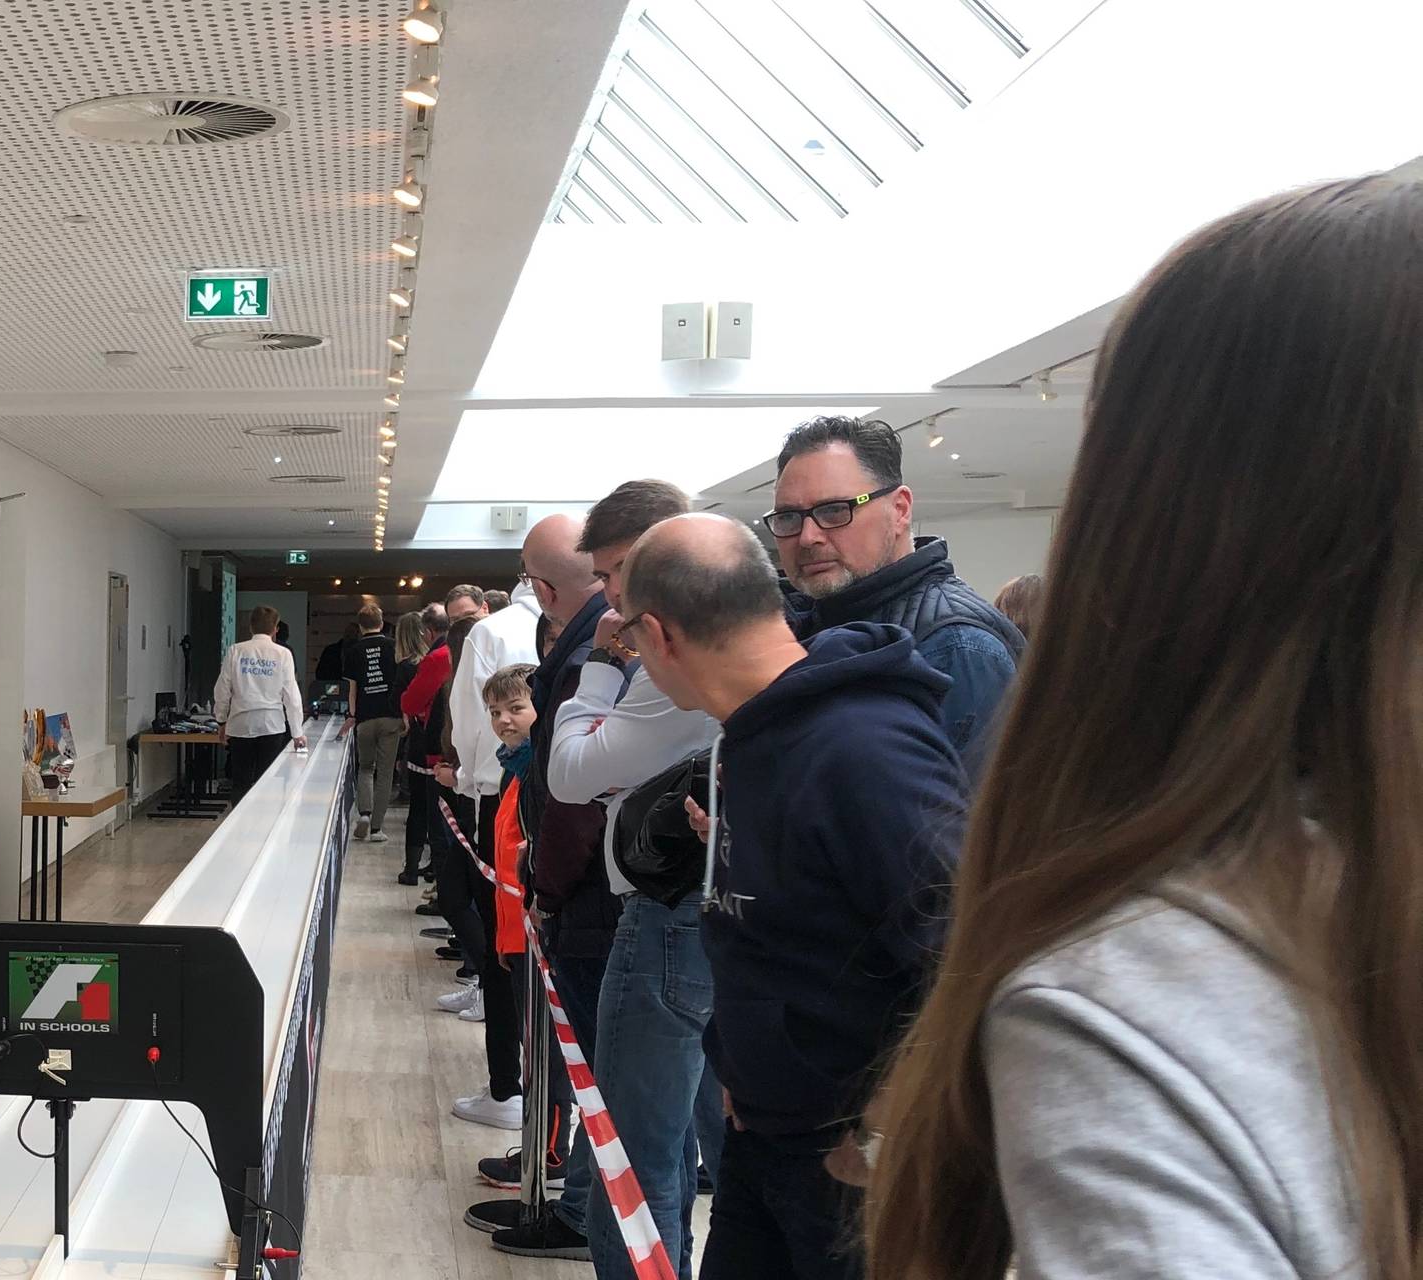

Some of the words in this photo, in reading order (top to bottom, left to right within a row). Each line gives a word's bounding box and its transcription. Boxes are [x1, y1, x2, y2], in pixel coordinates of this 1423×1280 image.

[240, 657, 277, 668] PEGASUS
[241, 667, 274, 676] RACING
[20, 1022, 36, 1031] IN
[40, 1023, 110, 1033] SCHOOLS
